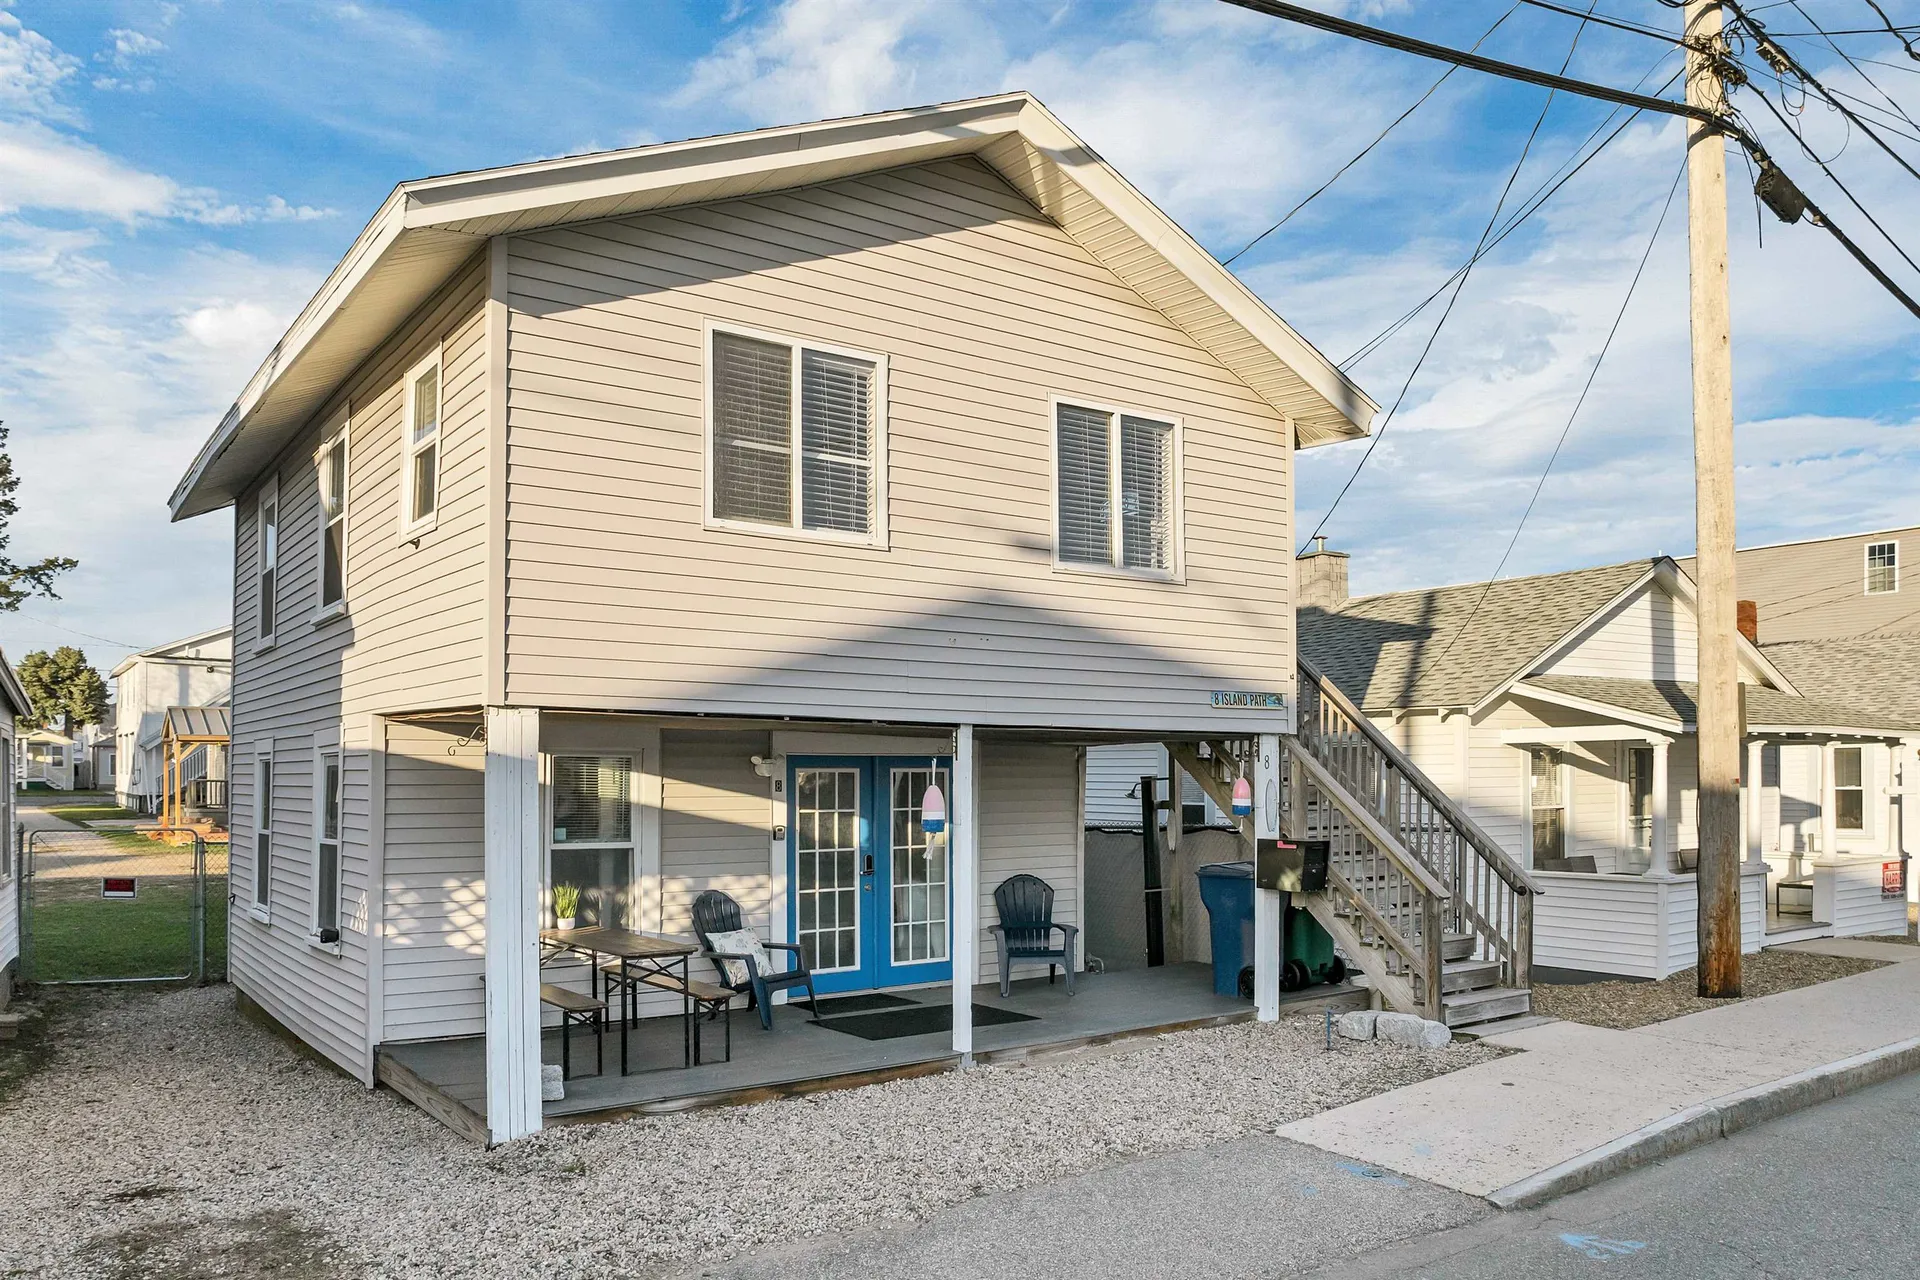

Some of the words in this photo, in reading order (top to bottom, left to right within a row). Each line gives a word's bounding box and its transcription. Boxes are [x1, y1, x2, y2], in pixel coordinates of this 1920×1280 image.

[1214, 692, 1220, 705] 8
[1221, 693, 1248, 706] ISLAND
[1249, 694, 1267, 707] PATH
[1264, 755, 1270, 769] 8
[776, 781, 782, 791] 8
